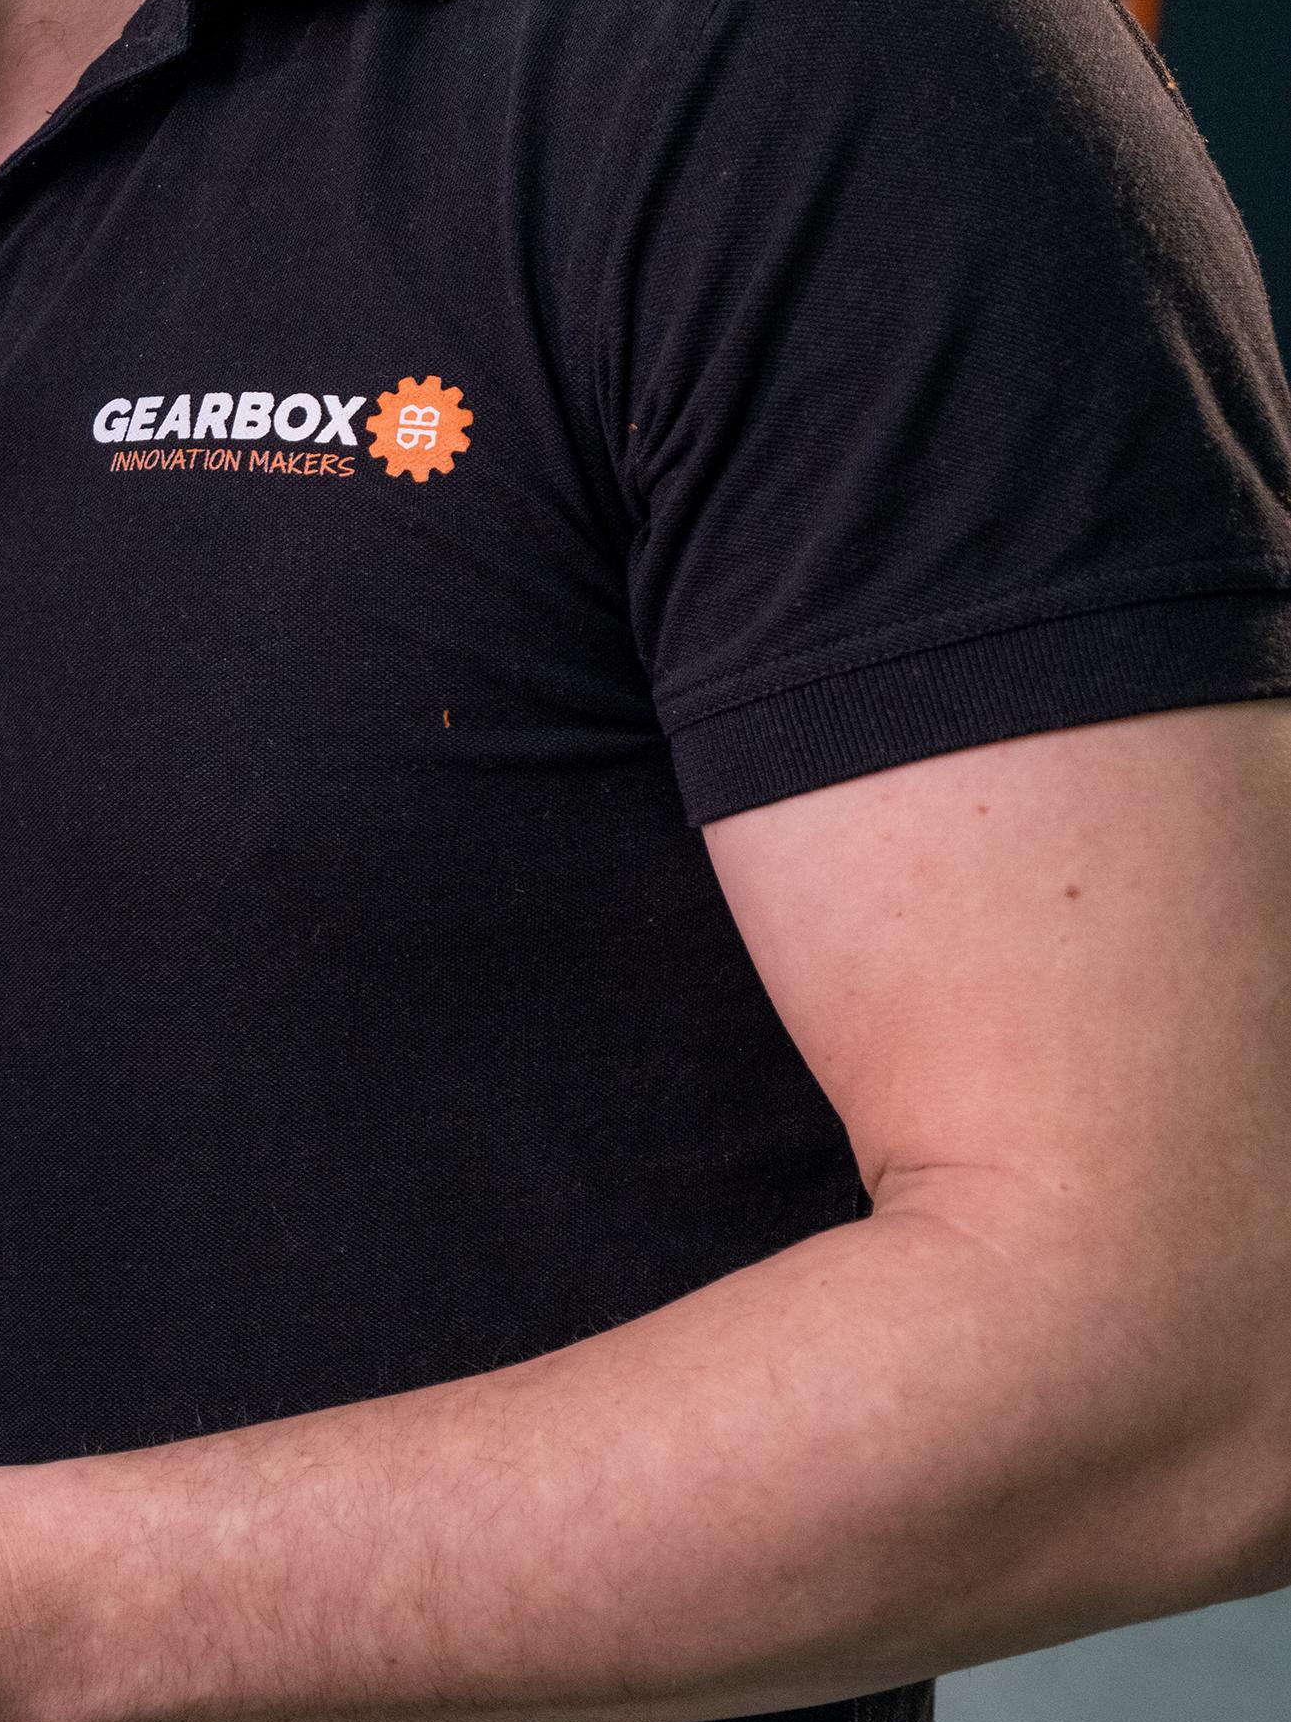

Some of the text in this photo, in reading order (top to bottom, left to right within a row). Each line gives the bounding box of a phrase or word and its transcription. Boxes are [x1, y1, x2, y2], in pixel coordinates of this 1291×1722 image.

[93, 391, 367, 446] GEARBOX
[110, 447, 357, 478] INNOVATION MAKERS
